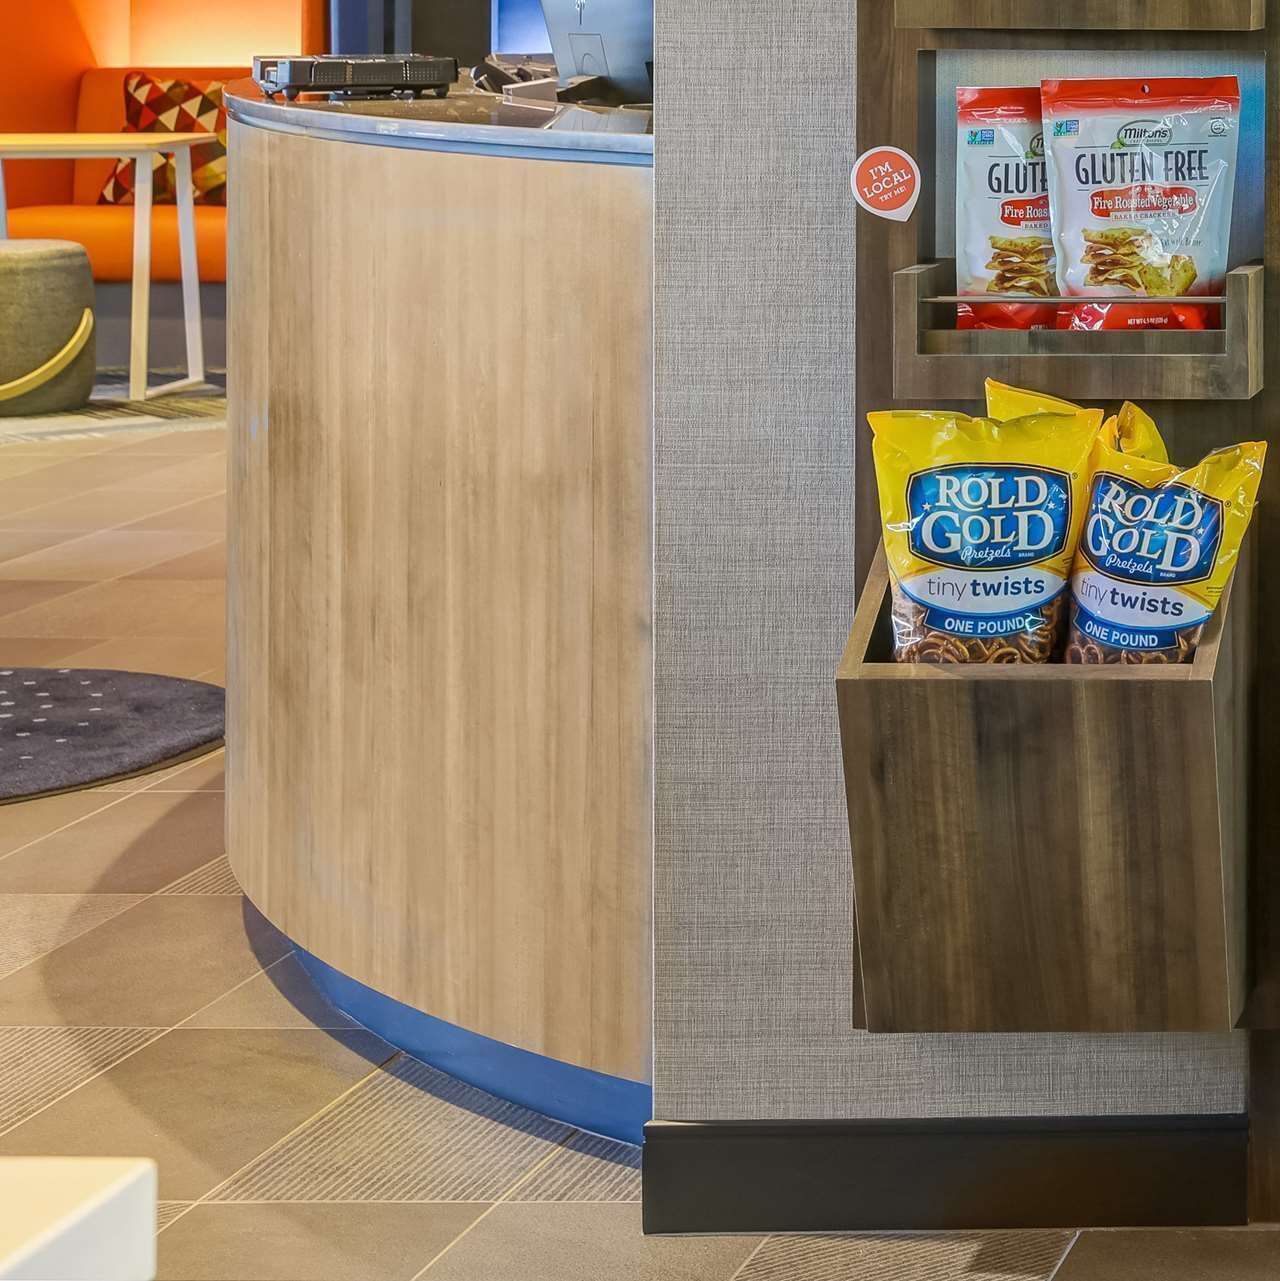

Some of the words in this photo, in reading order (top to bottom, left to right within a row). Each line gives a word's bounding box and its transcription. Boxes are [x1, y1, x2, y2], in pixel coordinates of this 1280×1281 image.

[1124, 127, 1169, 139] Milton's
[869, 163, 893, 179] I'M
[1075, 151, 1153, 184] GLUTEN
[1163, 150, 1209, 182] FREE
[863, 168, 911, 198] LOCAL
[879, 191, 893, 202] TRY
[893, 185, 908, 197] ME!
[1004, 206, 1024, 218] Fire
[1094, 197, 1114, 210] Fire
[1116, 196, 1149, 210] Roasted
[936, 475, 1048, 511] ROLD
[1100, 481, 1202, 532] ROLD
[922, 510, 1053, 552] GOLD
[1086, 513, 1200, 571] GOLD
[961, 545, 1011, 561] Pretzels
[1106, 554, 1153, 574] Pretzels
[927, 578, 966, 600] tiny
[971, 577, 1045, 597] twists
[1081, 578, 1110, 606] tiny
[1110, 589, 1183, 617] twists
[945, 618, 974, 631] ONE
[978, 616, 1026, 633] POUND
[1085, 622, 1109, 639] ONE
[1111, 629, 1158, 648] POUND
